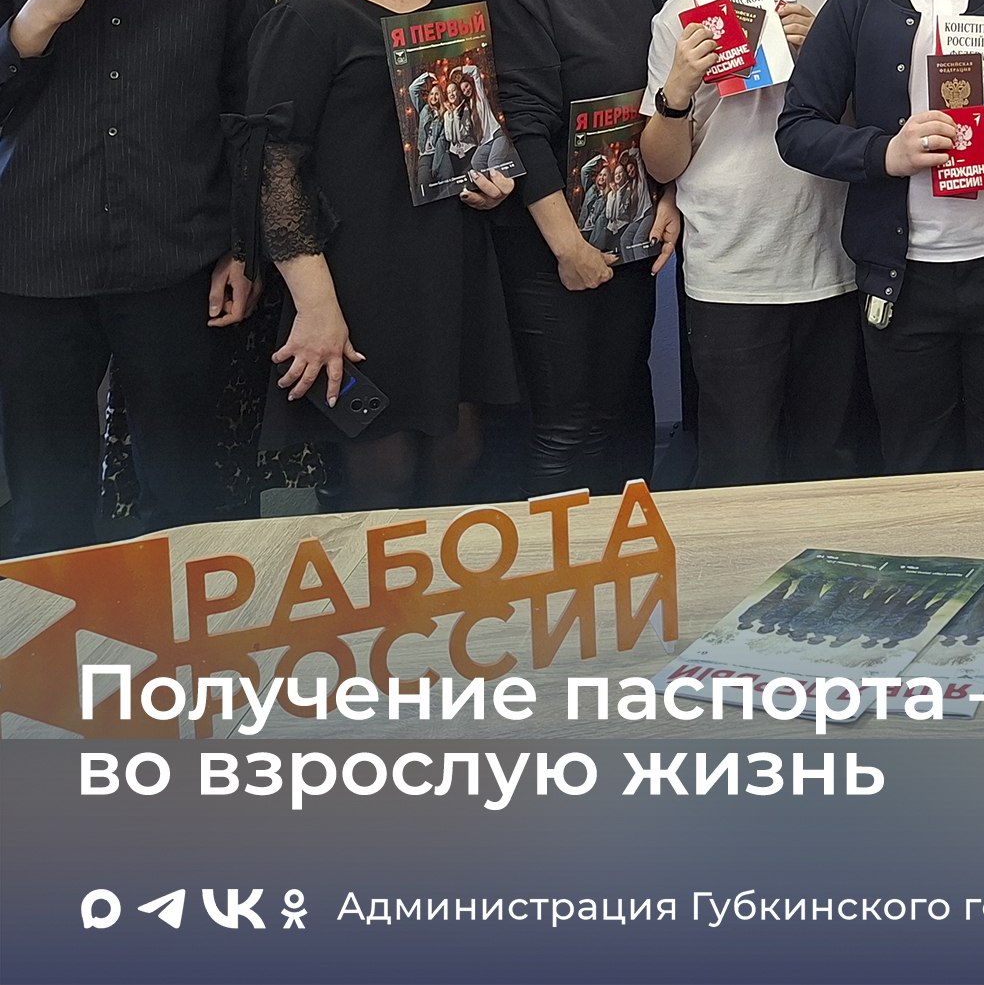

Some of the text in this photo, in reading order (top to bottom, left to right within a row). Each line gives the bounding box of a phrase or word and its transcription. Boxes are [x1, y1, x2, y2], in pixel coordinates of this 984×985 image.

[391, 27, 406, 48] Я
[410, 10, 486, 44] ПЕРВЫЙ
[717, 44, 750, 63] ЖДАНЕ
[576, 113, 588, 130] Я
[593, 105, 640, 128] ПЕРВЫ
[939, 176, 983, 191] РОССИИ!
[185, 478, 676, 640] РАБОТА
[192, 572, 679, 740] РОССИИ
